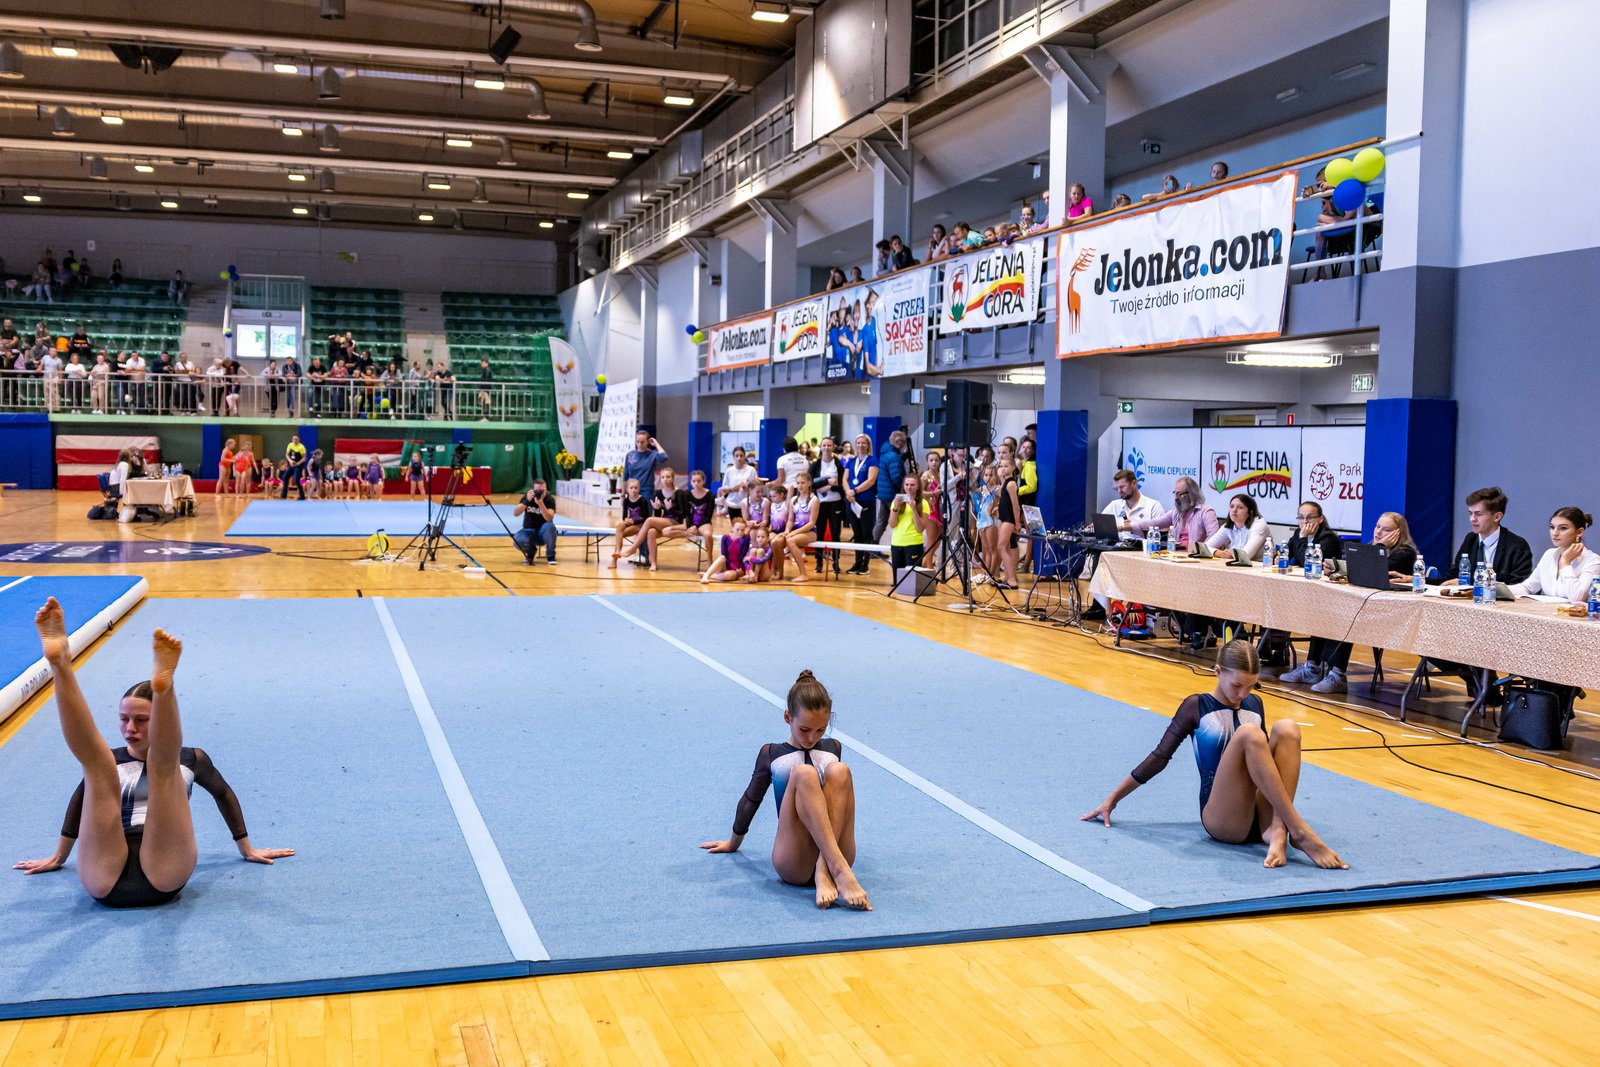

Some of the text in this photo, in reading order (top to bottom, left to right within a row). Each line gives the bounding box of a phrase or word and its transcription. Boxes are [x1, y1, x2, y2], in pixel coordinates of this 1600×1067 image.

[972, 251, 1024, 284] JELENIA
[1094, 227, 1283, 295] Jelonka.com
[893, 296, 925, 320] STREFA
[1110, 299, 1143, 315] Twoje
[1145, 290, 1179, 309] źródło
[885, 316, 924, 341] SQUASH
[894, 336, 924, 355] FITNESS
[1148, 466, 1197, 476] TERMY CIEPLICKIE
[1234, 451, 1290, 473] JELENIA
[1339, 463, 1361, 476] Park
[1247, 473, 1289, 499] GÓRA
